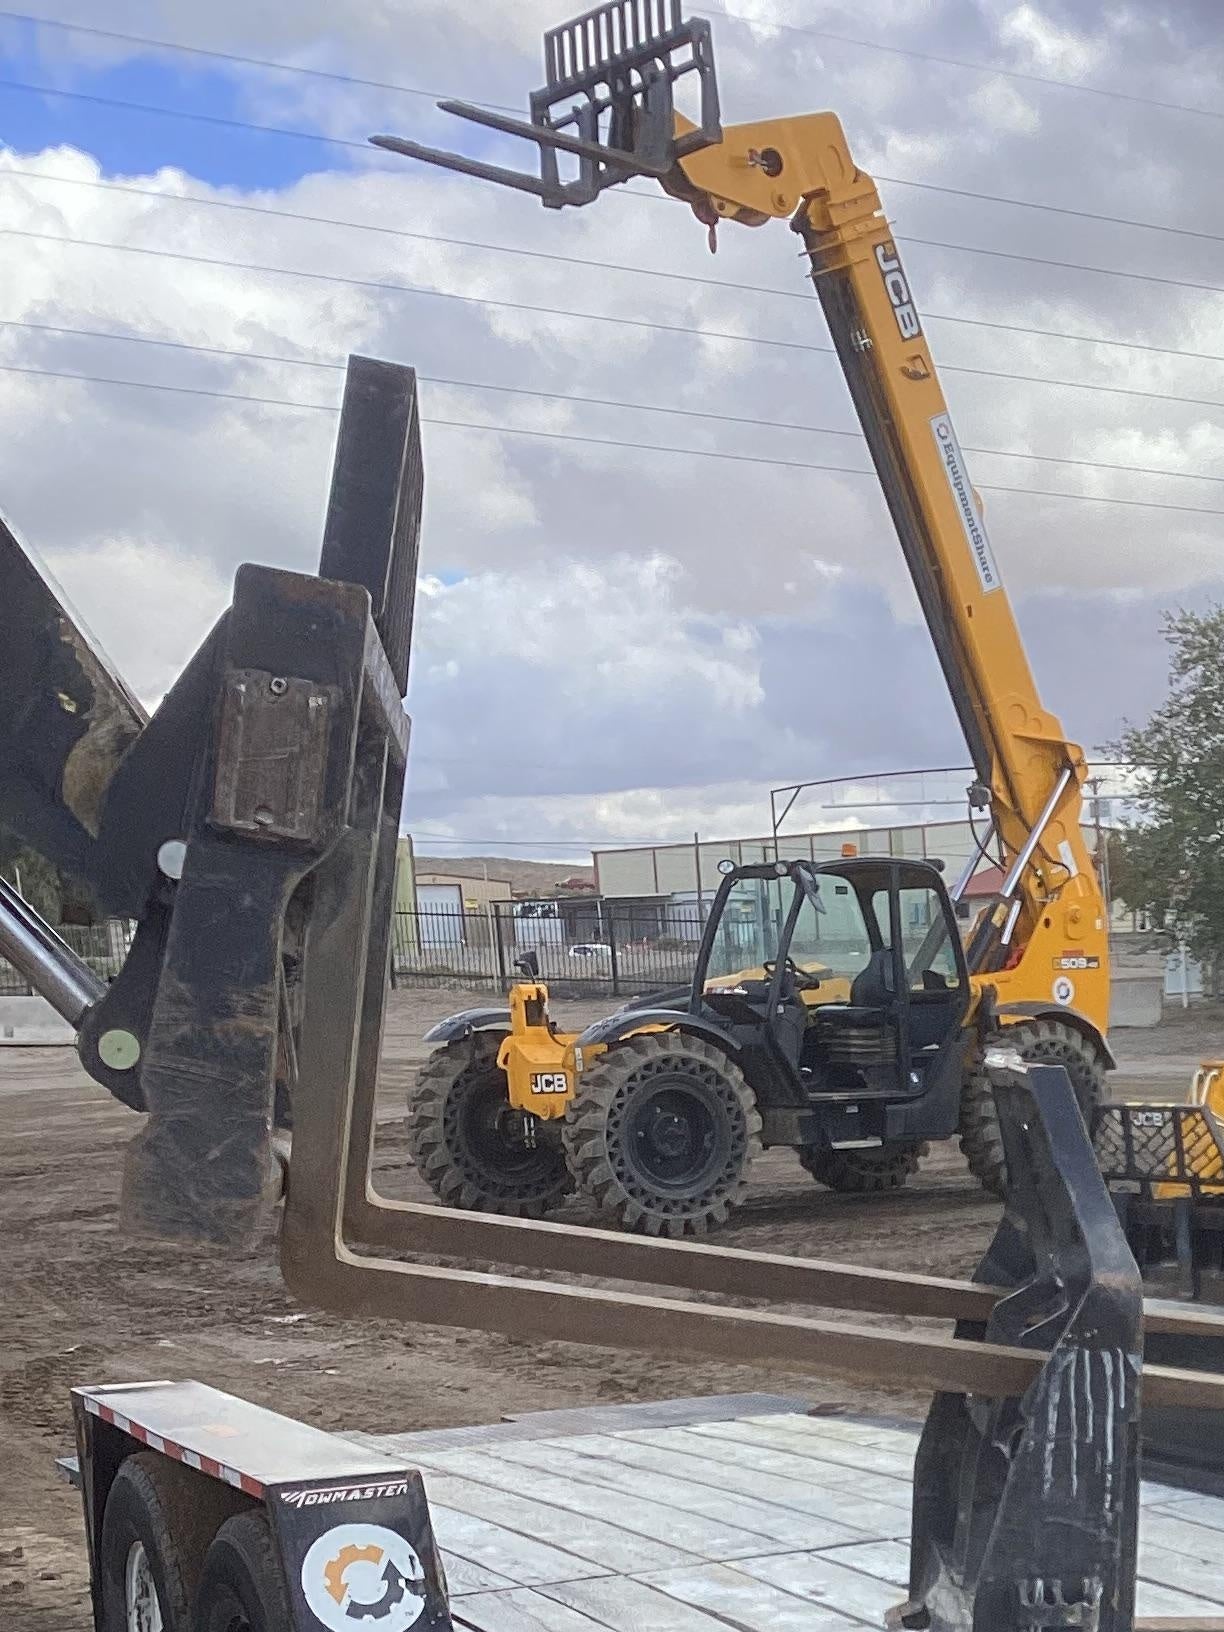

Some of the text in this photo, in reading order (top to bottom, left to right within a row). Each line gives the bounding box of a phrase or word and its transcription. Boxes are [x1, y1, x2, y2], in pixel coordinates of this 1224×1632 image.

[876, 245, 919, 338] JCB
[943, 442, 993, 584] EquipmentShare
[532, 1074, 567, 1093] JCB
[1134, 1112, 1163, 1126] JCB
[280, 1479, 408, 1508] TOWMASTER
